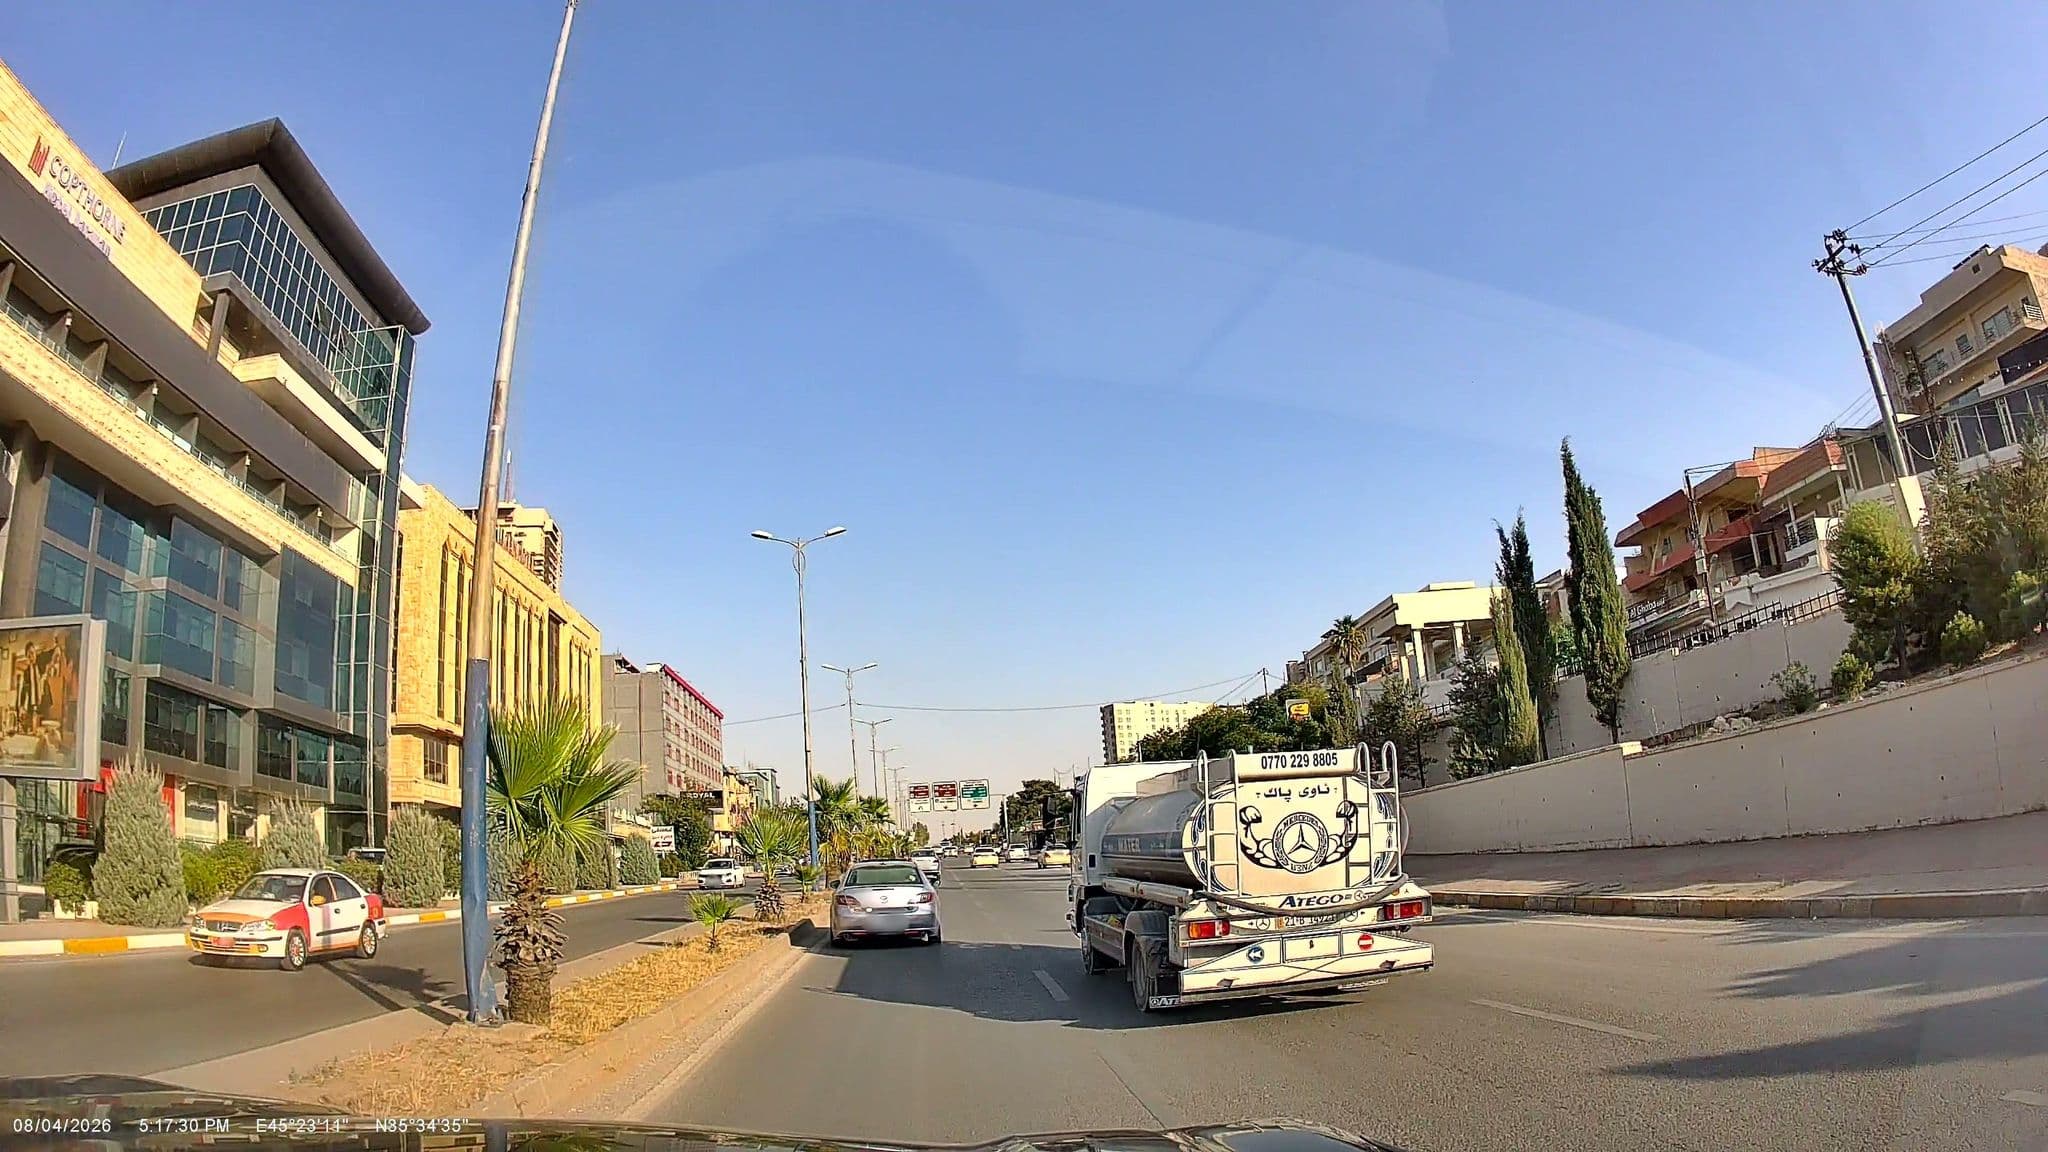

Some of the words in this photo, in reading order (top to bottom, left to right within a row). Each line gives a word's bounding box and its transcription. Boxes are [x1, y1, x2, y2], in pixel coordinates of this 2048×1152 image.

[49, 155, 126, 245] COPTHORNE
[1261, 754, 1287, 770] 0770
[1290, 753, 1310, 768] 229
[1313, 752, 1338, 767] 8805
[1278, 894, 1344, 909] ATEGO
